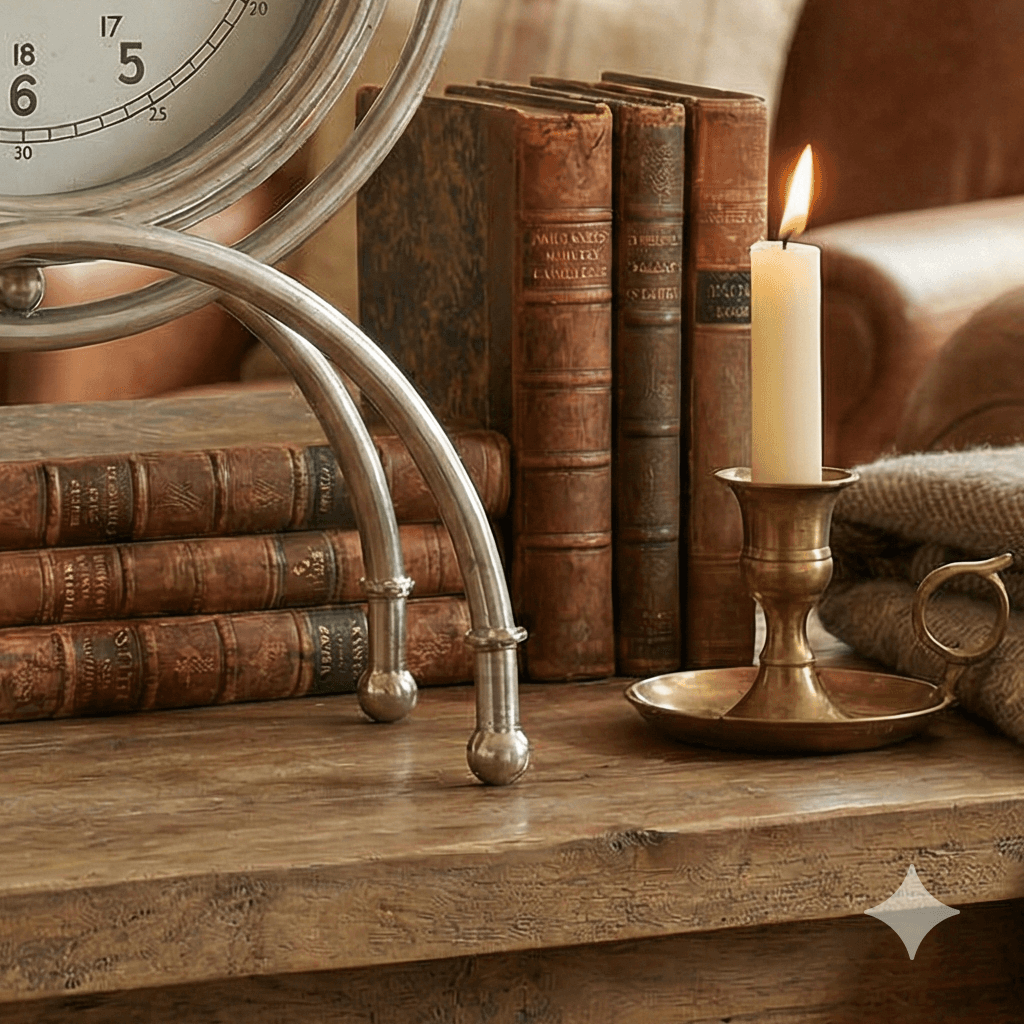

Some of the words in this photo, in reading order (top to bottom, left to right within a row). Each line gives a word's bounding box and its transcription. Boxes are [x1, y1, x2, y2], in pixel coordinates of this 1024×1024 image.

[249, 1, 268, 16] 20
[102, 16, 123, 37] 17
[14, 43, 35, 66] 18
[118, 42, 144, 84] 5
[10, 74, 37, 116] 6
[149, 107, 167, 122] 25
[14, 146, 32, 160] 30
